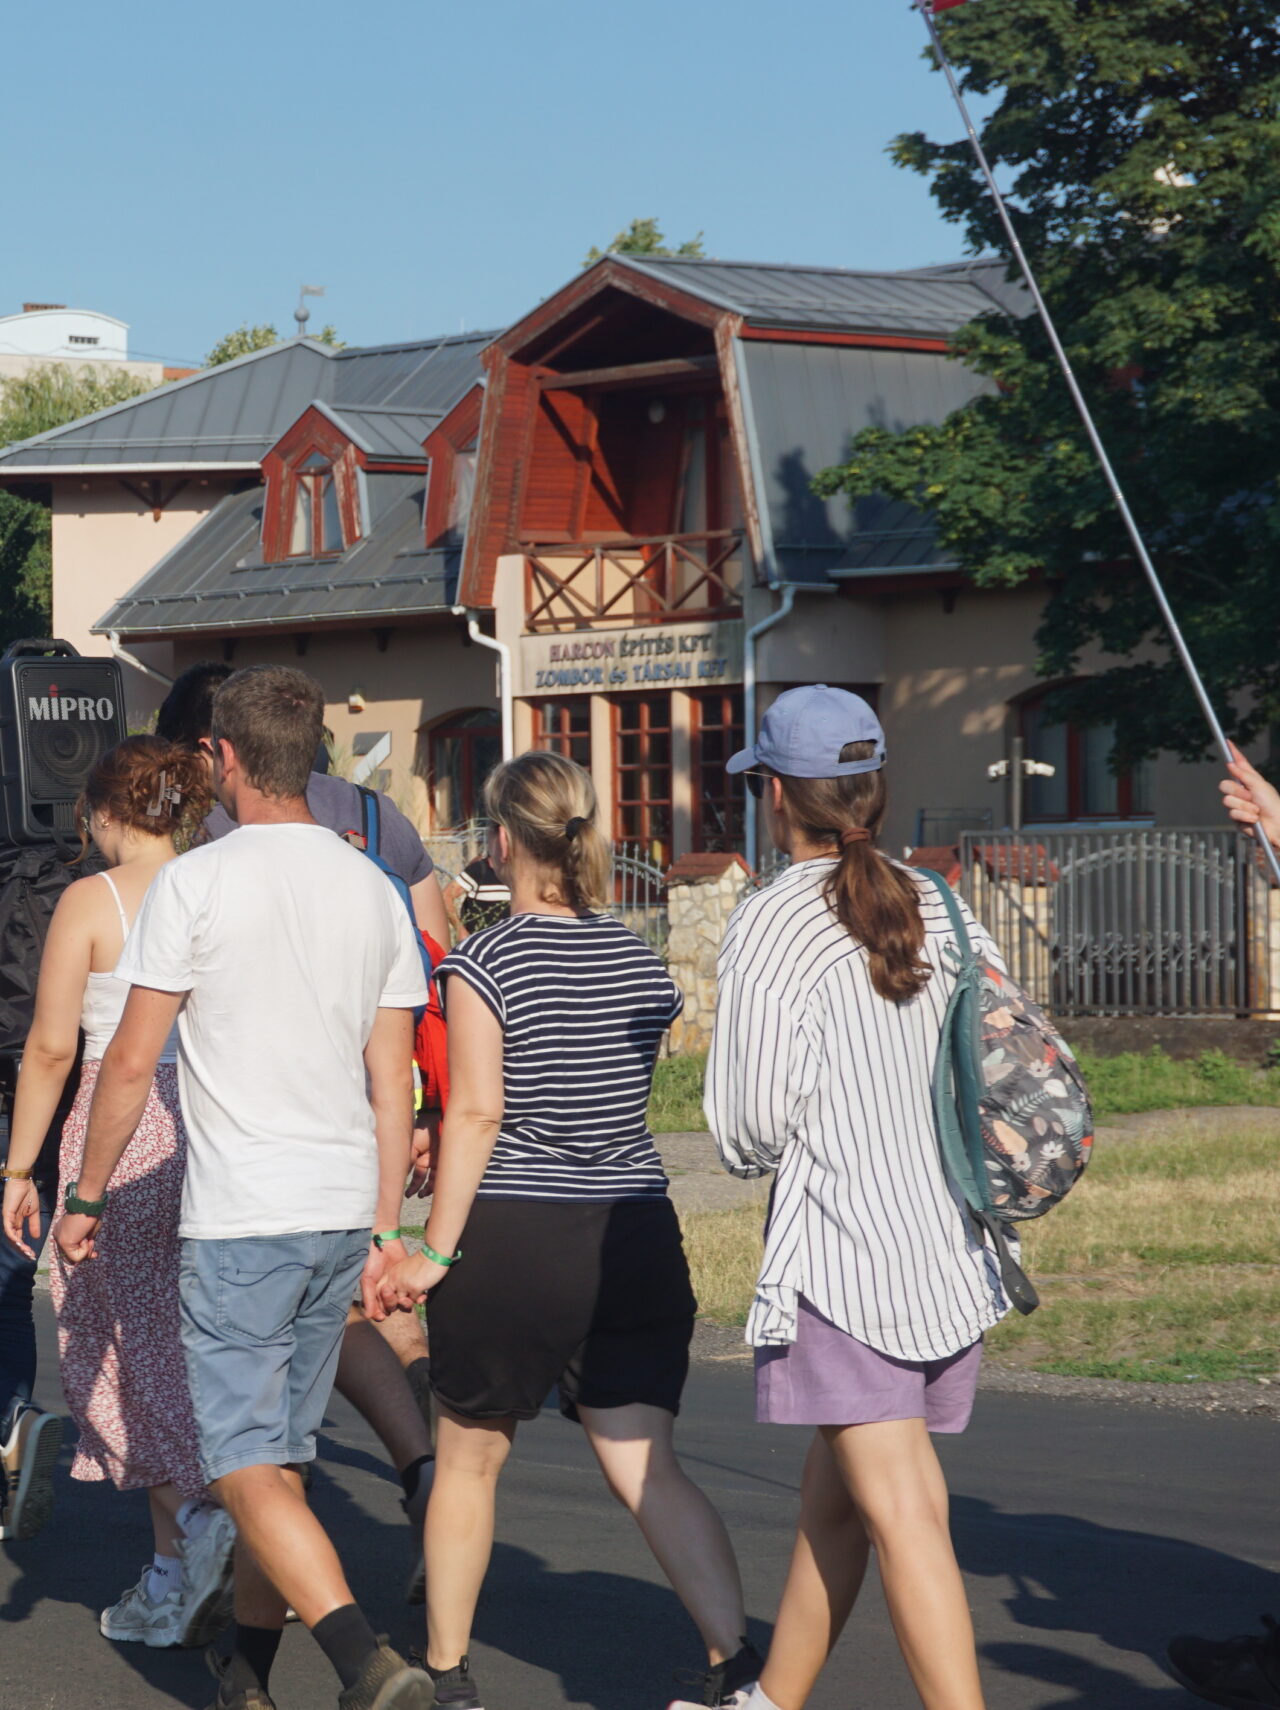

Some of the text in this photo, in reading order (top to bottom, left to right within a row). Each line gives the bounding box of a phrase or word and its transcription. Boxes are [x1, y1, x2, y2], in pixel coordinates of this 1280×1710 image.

[620, 632, 673, 658] ÉPÍTÉS
[678, 633, 713, 654] KFT
[535, 658, 727, 688] ZOMBOR és TÁRSAI KFT
